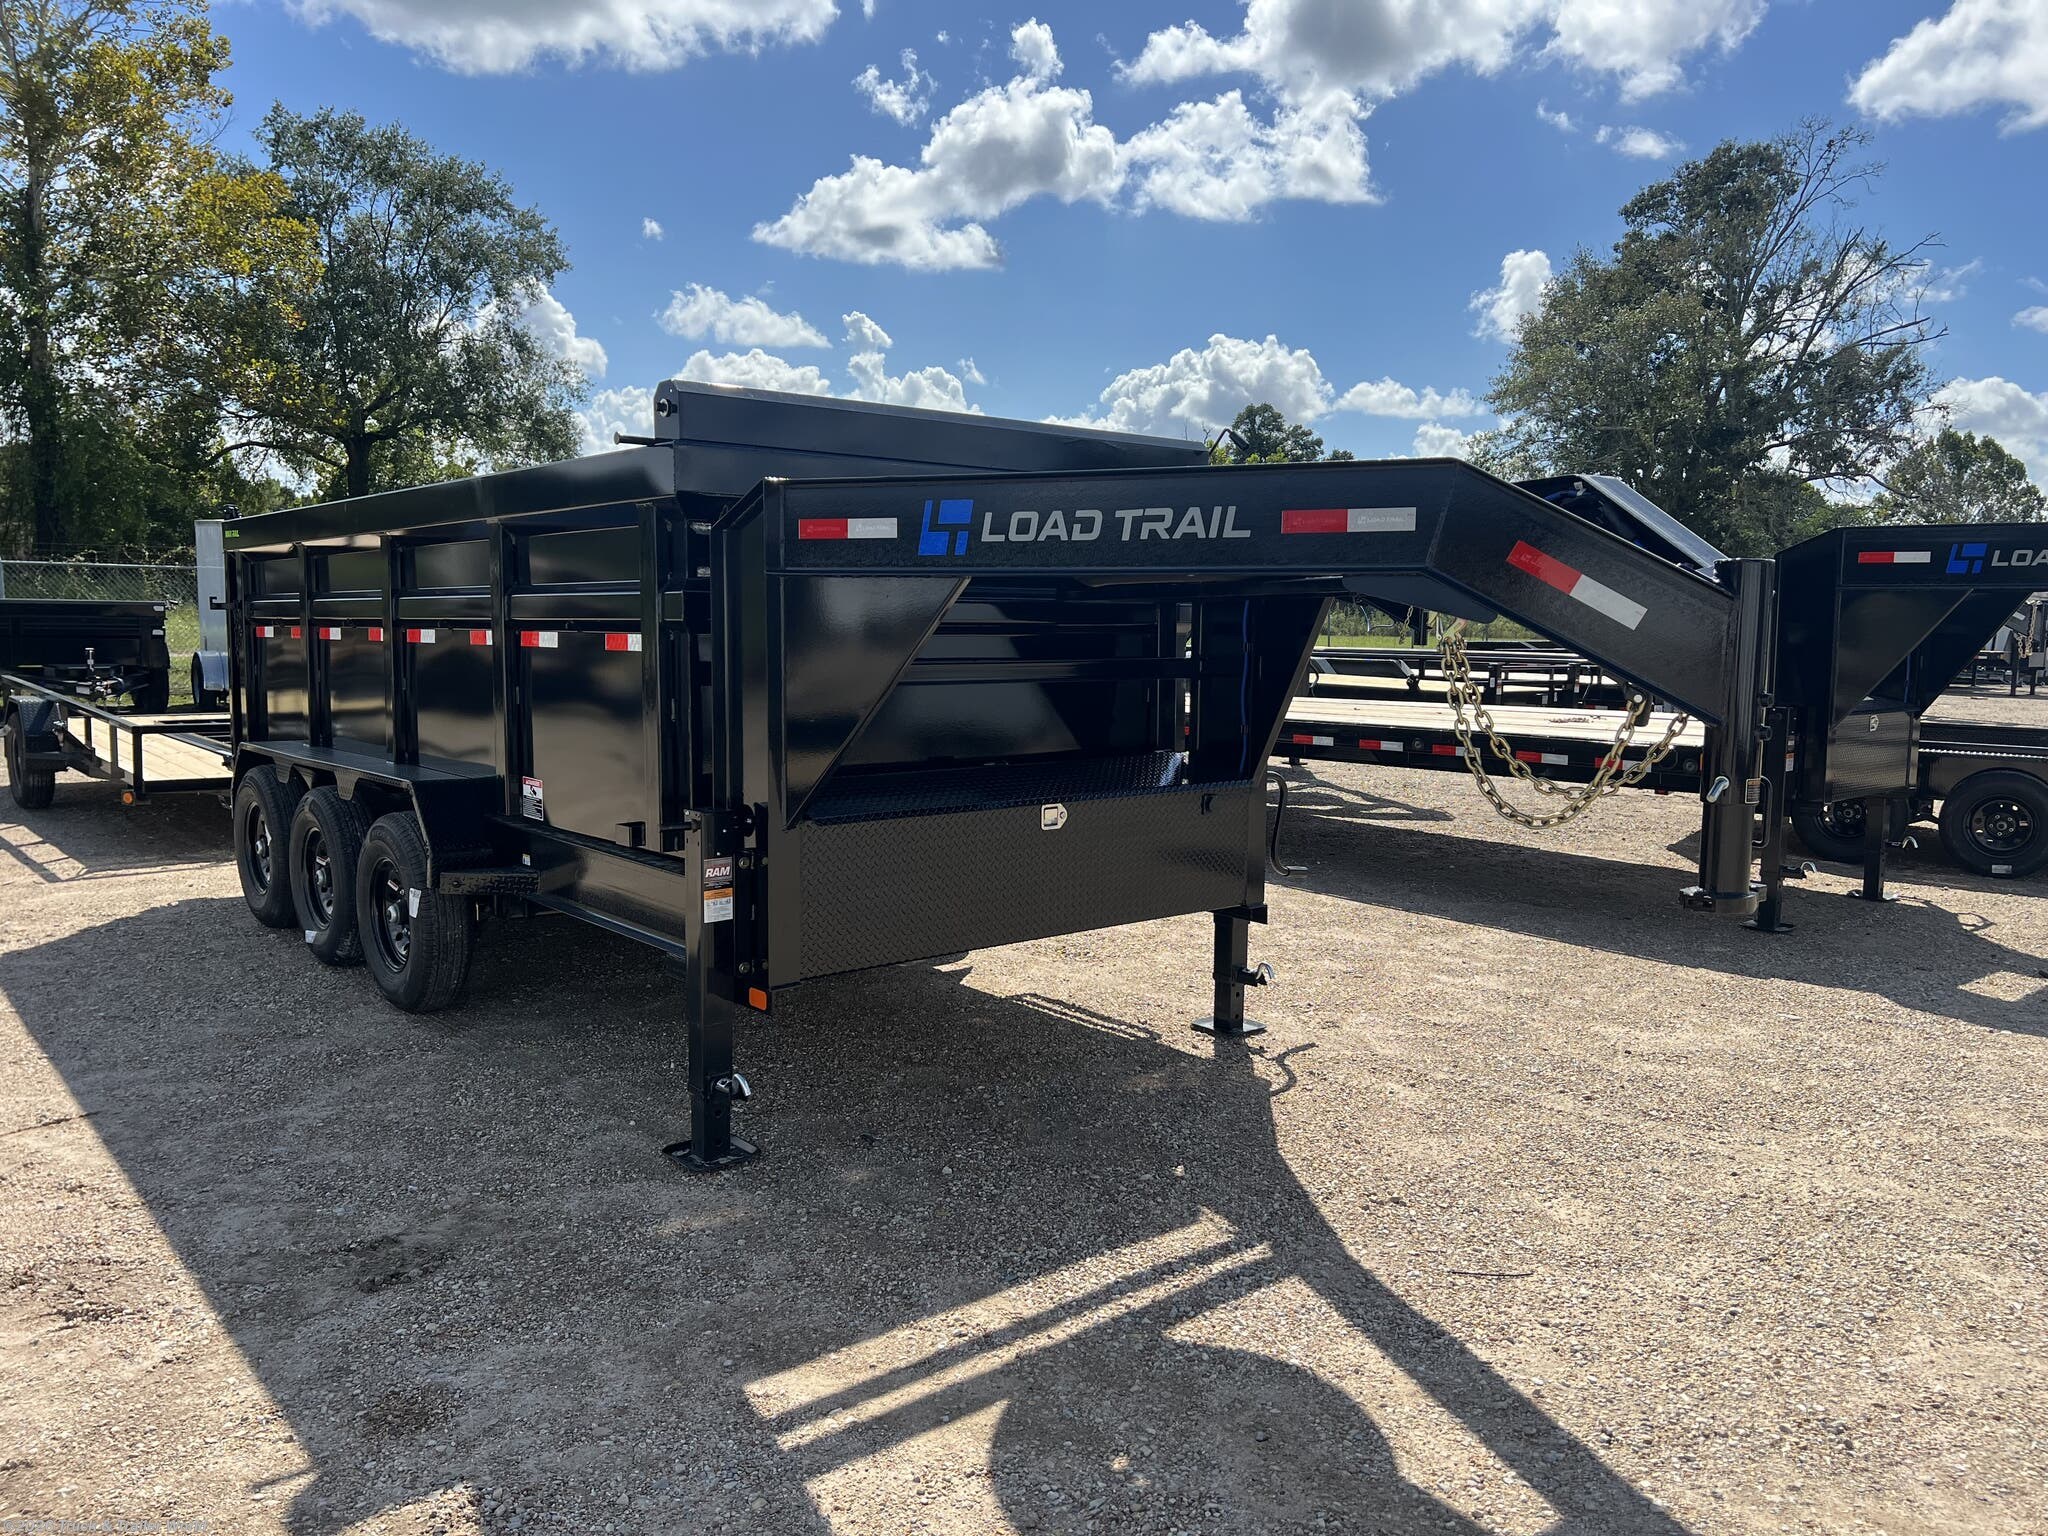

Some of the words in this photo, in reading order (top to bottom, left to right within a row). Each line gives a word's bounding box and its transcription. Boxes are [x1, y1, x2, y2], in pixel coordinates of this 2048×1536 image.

[981, 510, 1103, 542] LOAD
[1115, 505, 1251, 541] TRAIL
[705, 866, 731, 878] RAM
